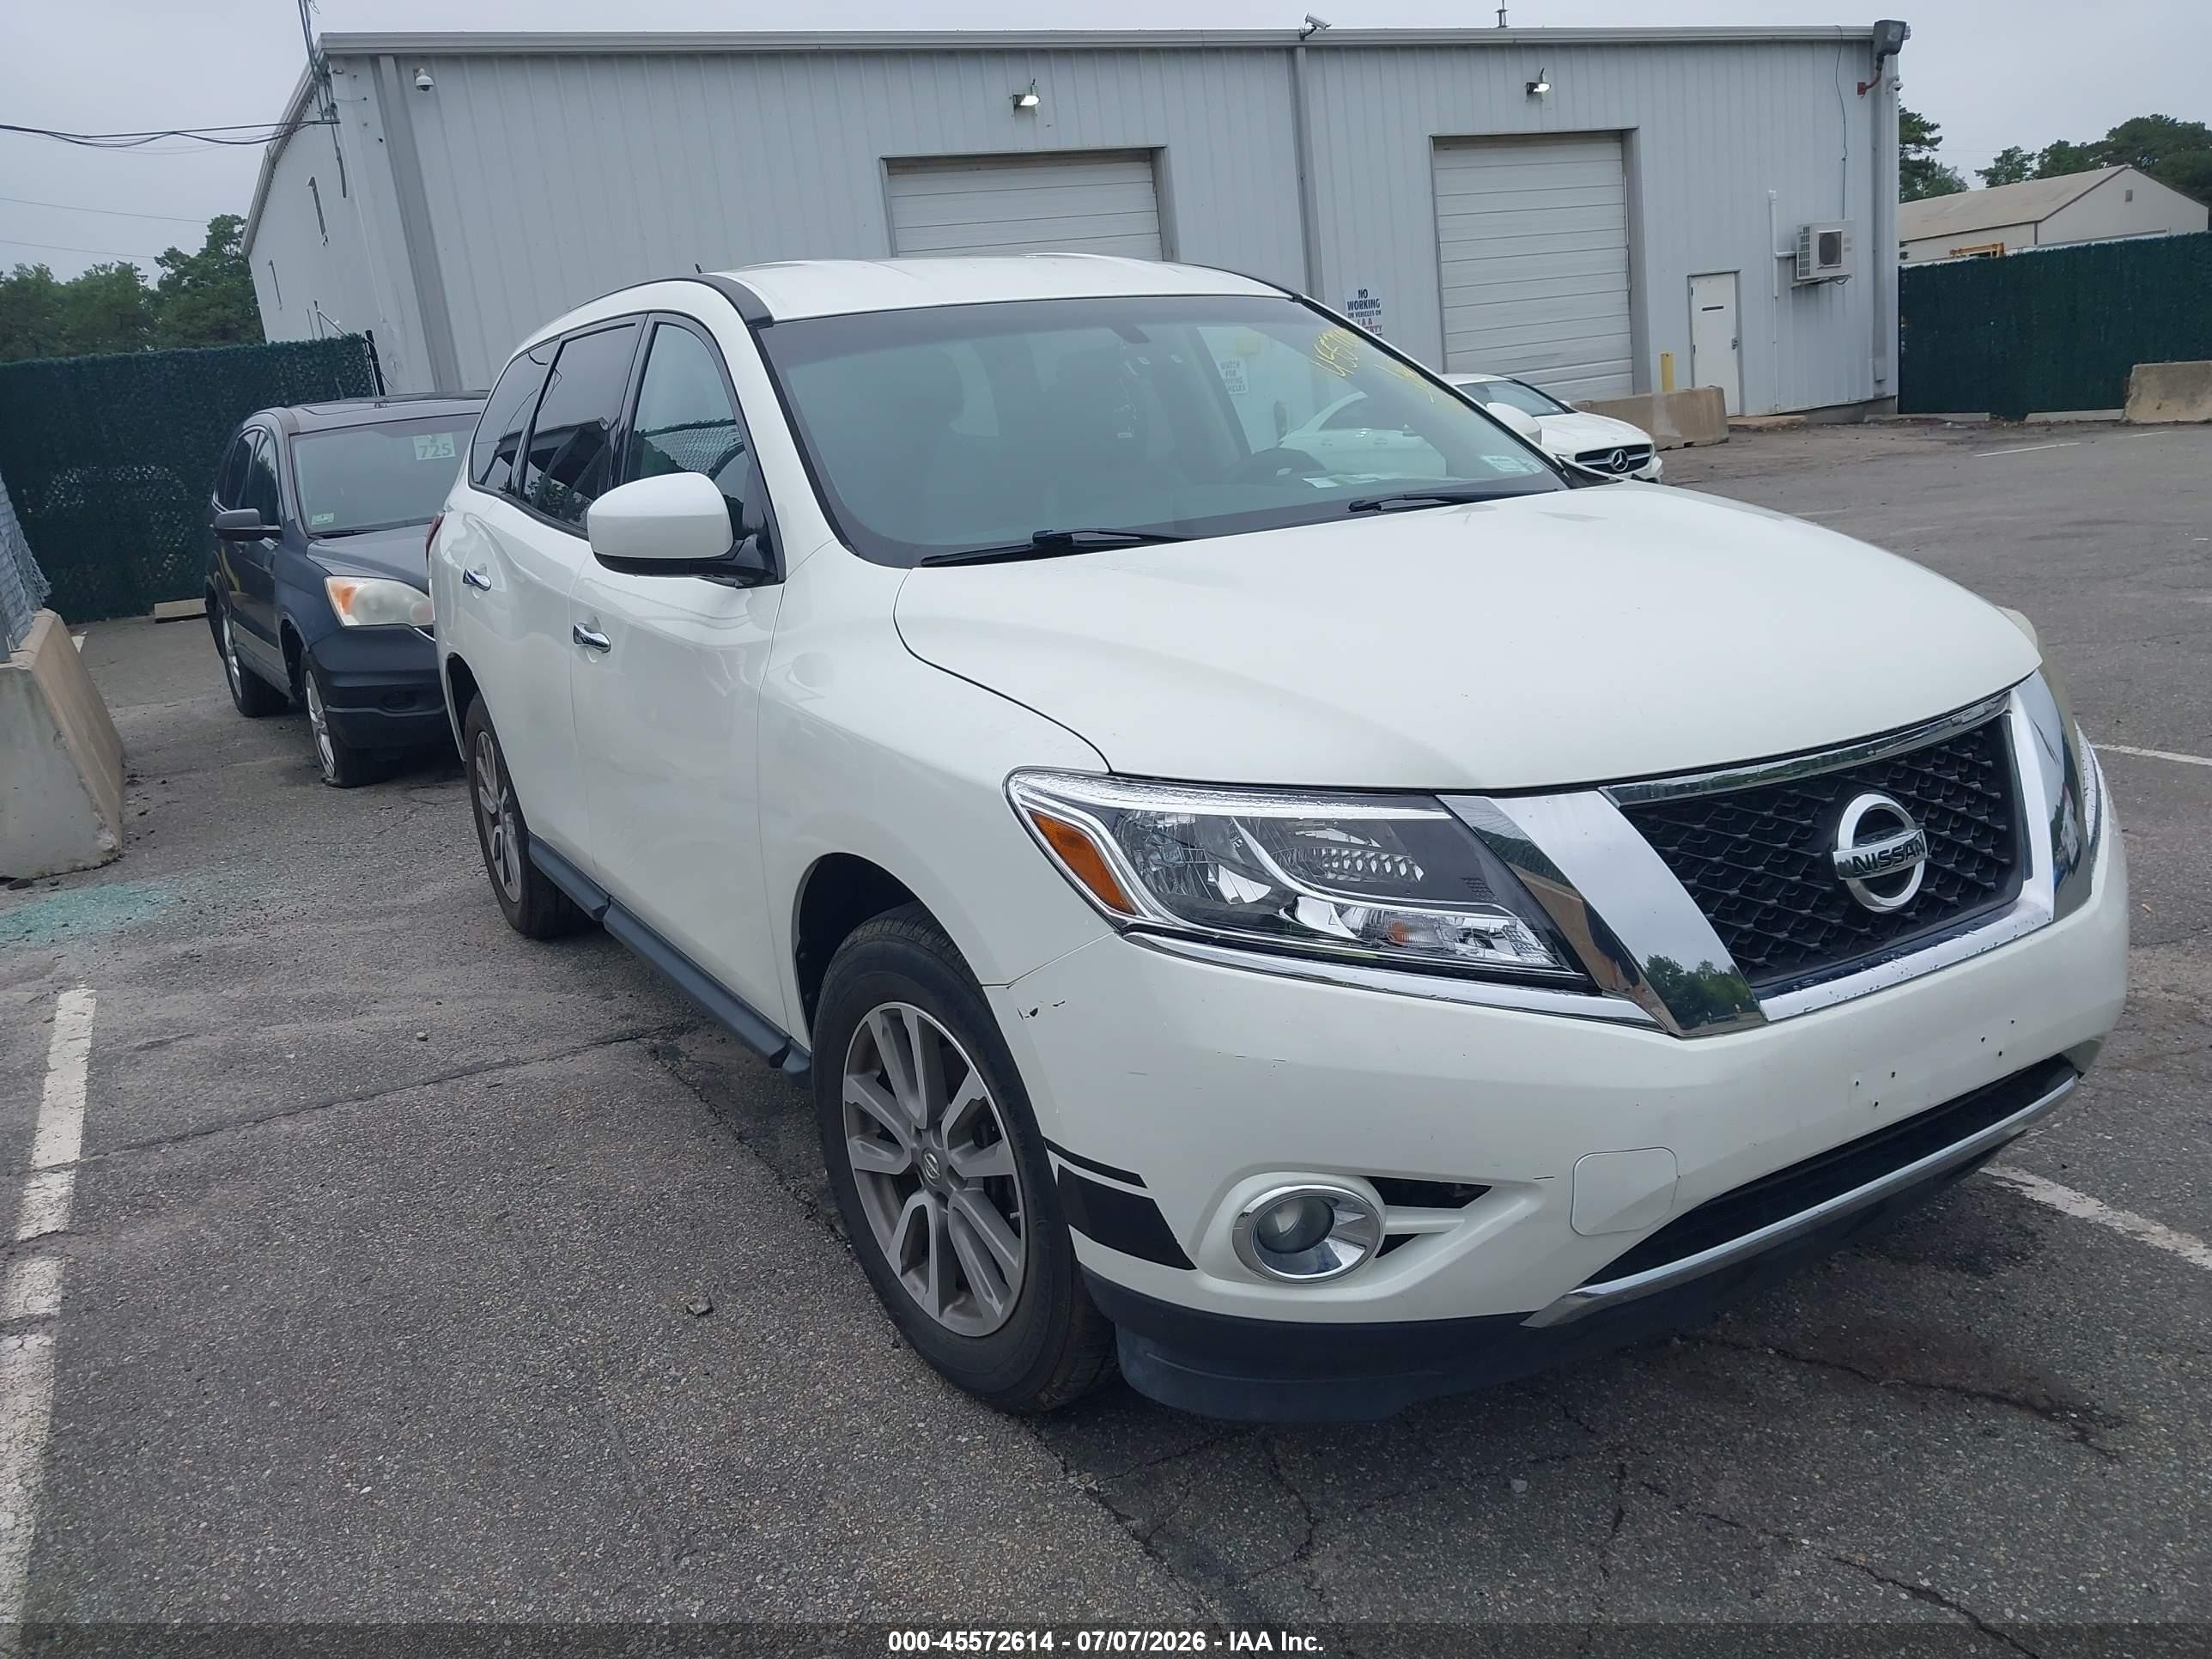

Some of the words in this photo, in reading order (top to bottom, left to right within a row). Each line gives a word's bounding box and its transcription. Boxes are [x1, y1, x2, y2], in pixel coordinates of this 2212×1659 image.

[1358, 289, 1368, 299] NO
[1346, 299, 1381, 311] WORKING
[419, 442, 452, 458] 725
[1851, 833, 1925, 873] NISSAN
